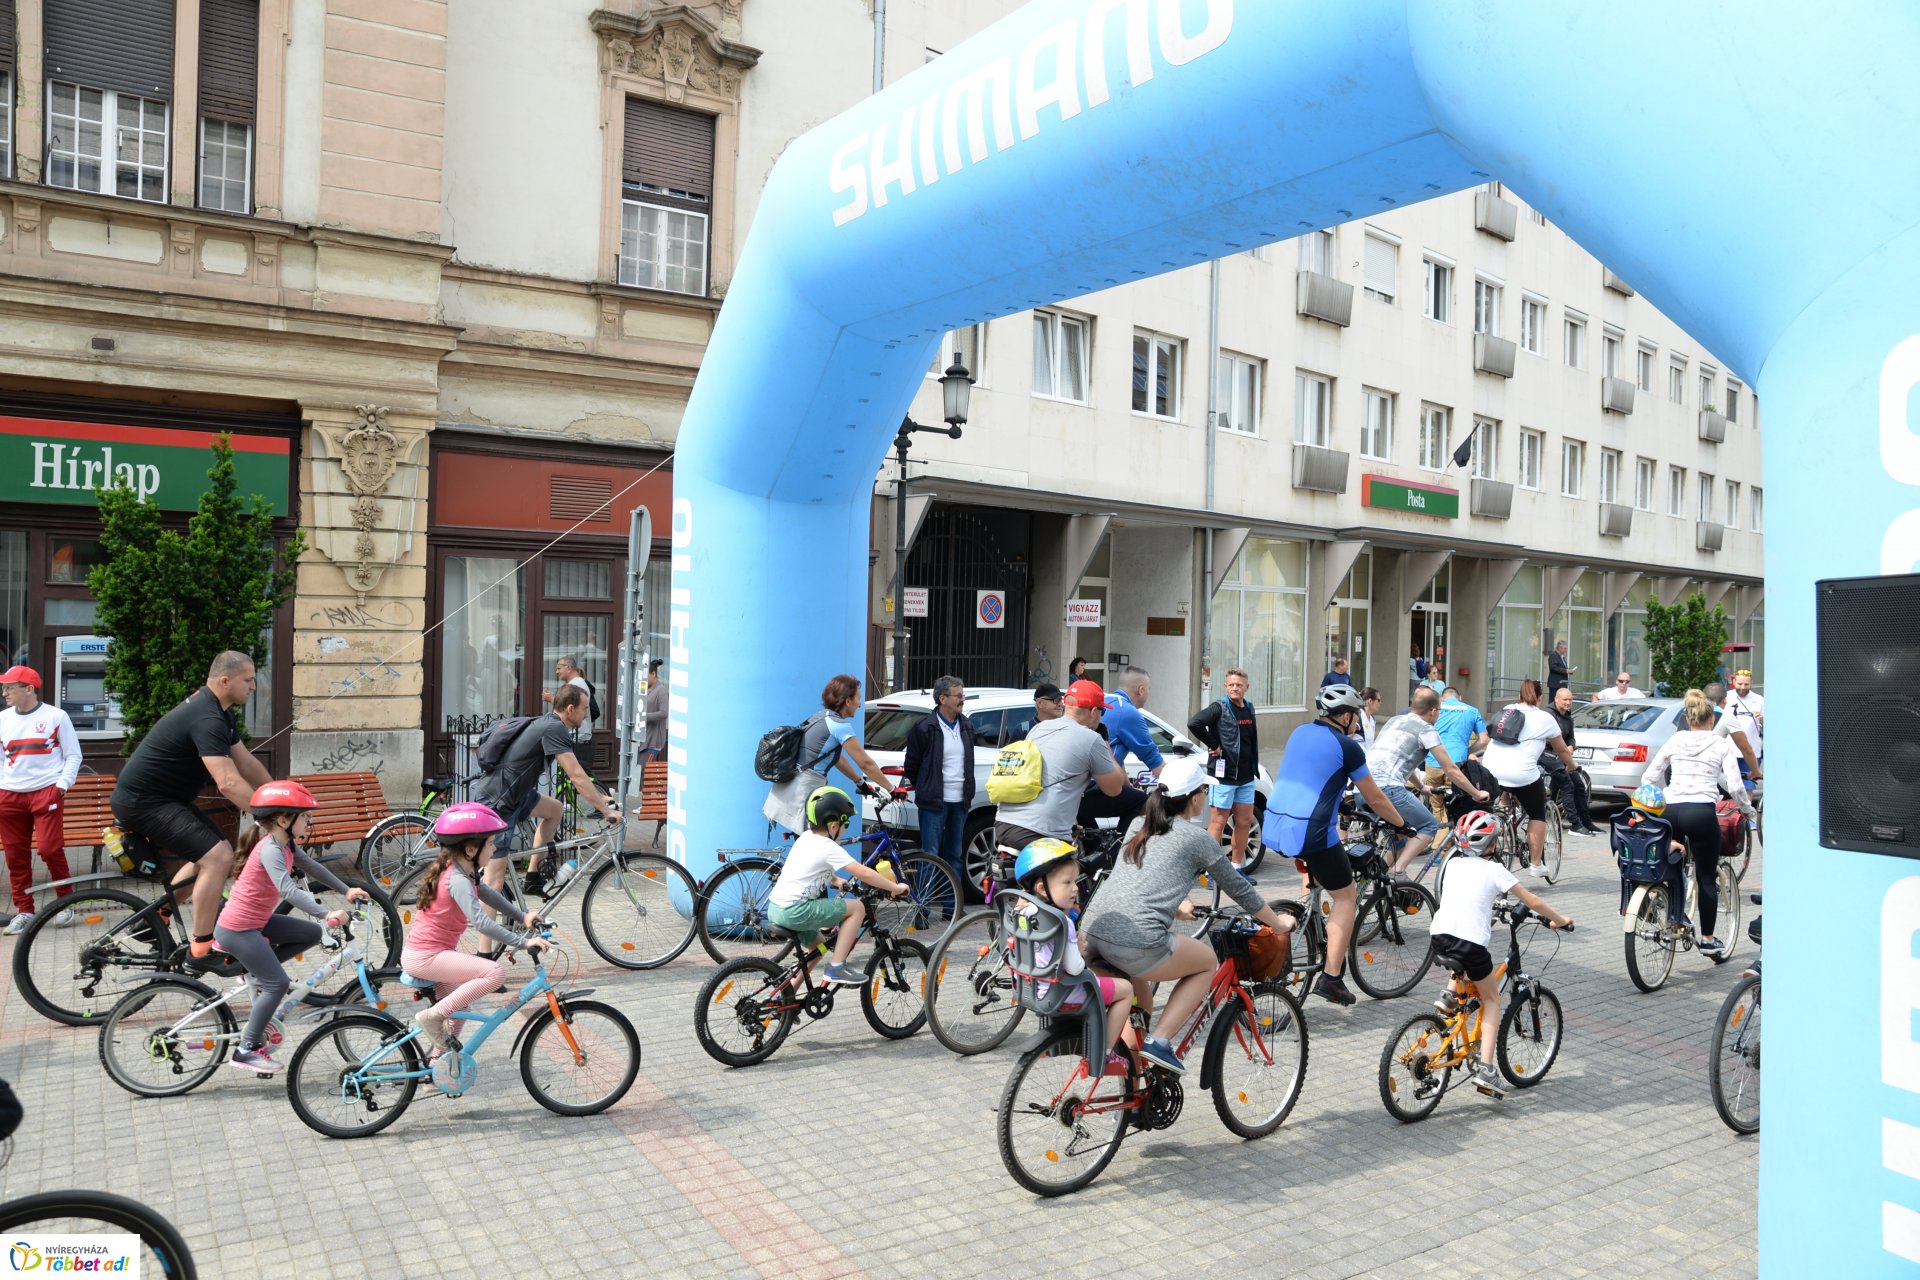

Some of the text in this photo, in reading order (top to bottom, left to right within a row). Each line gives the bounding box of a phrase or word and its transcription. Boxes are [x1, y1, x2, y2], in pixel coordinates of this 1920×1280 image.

[29, 441, 160, 504] Hírlap
[1407, 489, 1426, 508] Posta
[1068, 602, 1099, 613] VIGYÁZZ
